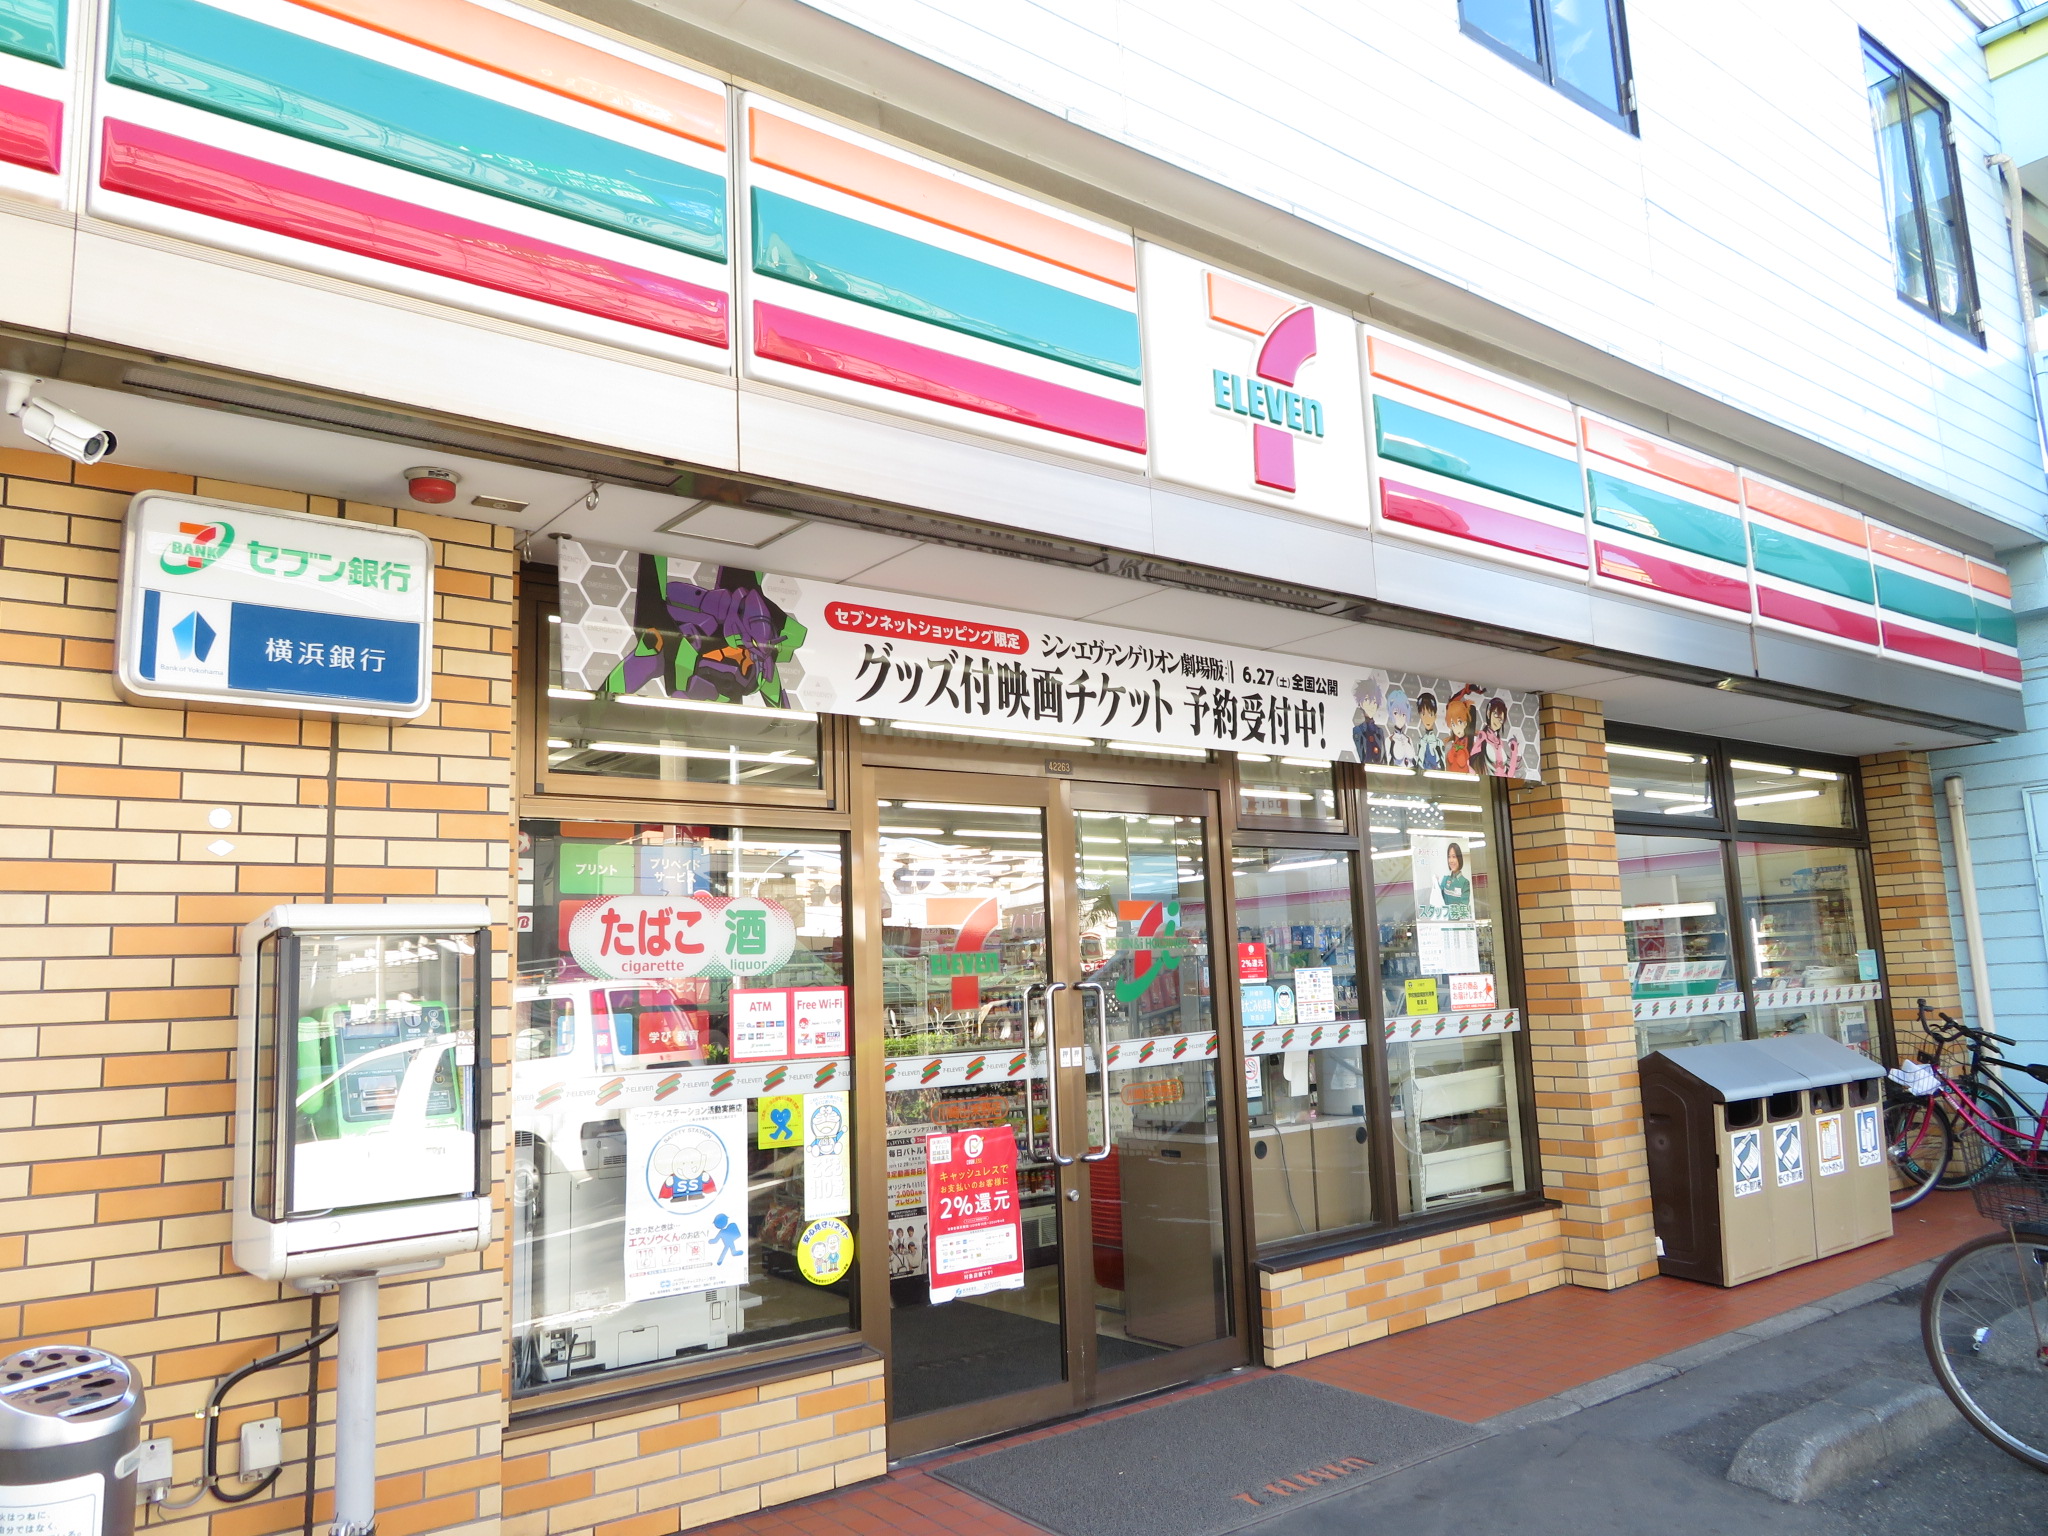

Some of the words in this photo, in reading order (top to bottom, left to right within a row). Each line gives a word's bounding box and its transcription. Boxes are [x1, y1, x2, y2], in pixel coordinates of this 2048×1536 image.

[171, 540, 221, 561] BANK
[247, 540, 411, 593] セブン銀行
[586, 581, 622, 590] EMERGENCY
[767, 584, 798, 595] EMERGENCY
[587, 626, 623, 635] EMERGENCY
[835, 608, 1021, 649] セブンネットショッピング限定
[265, 638, 387, 673] 横浜銀行
[855, 642, 1173, 733] グッズ付映画チケット
[1048, 762, 1070, 772] 42263
[576, 863, 617, 875] プリント
[1419, 904, 1472, 919] スタッフ募集!
[601, 907, 704, 956] たばこ
[725, 909, 767, 955] 酒
[621, 960, 684, 974] cigarette
[730, 959, 767, 973] liquor
[750, 1001, 772, 1012] ATM
[797, 1000, 816, 1010] Free
[819, 998, 842, 1009] Wi-Fi
[649, 1032, 672, 1044] 学び
[664, 1129, 686, 1143] SAFETY
[688, 1128, 712, 1139] STATION
[940, 1165, 1009, 1182] キャッシュレスで
[1820, 1161, 1843, 1173] ペットボトル
[940, 1177, 1009, 1194] お支払いのお客様に
[940, 1190, 1011, 1219] 2%還元
[803, 1221, 848, 1243] 安心見守りネット
[664, 1246, 679, 1254] 119
